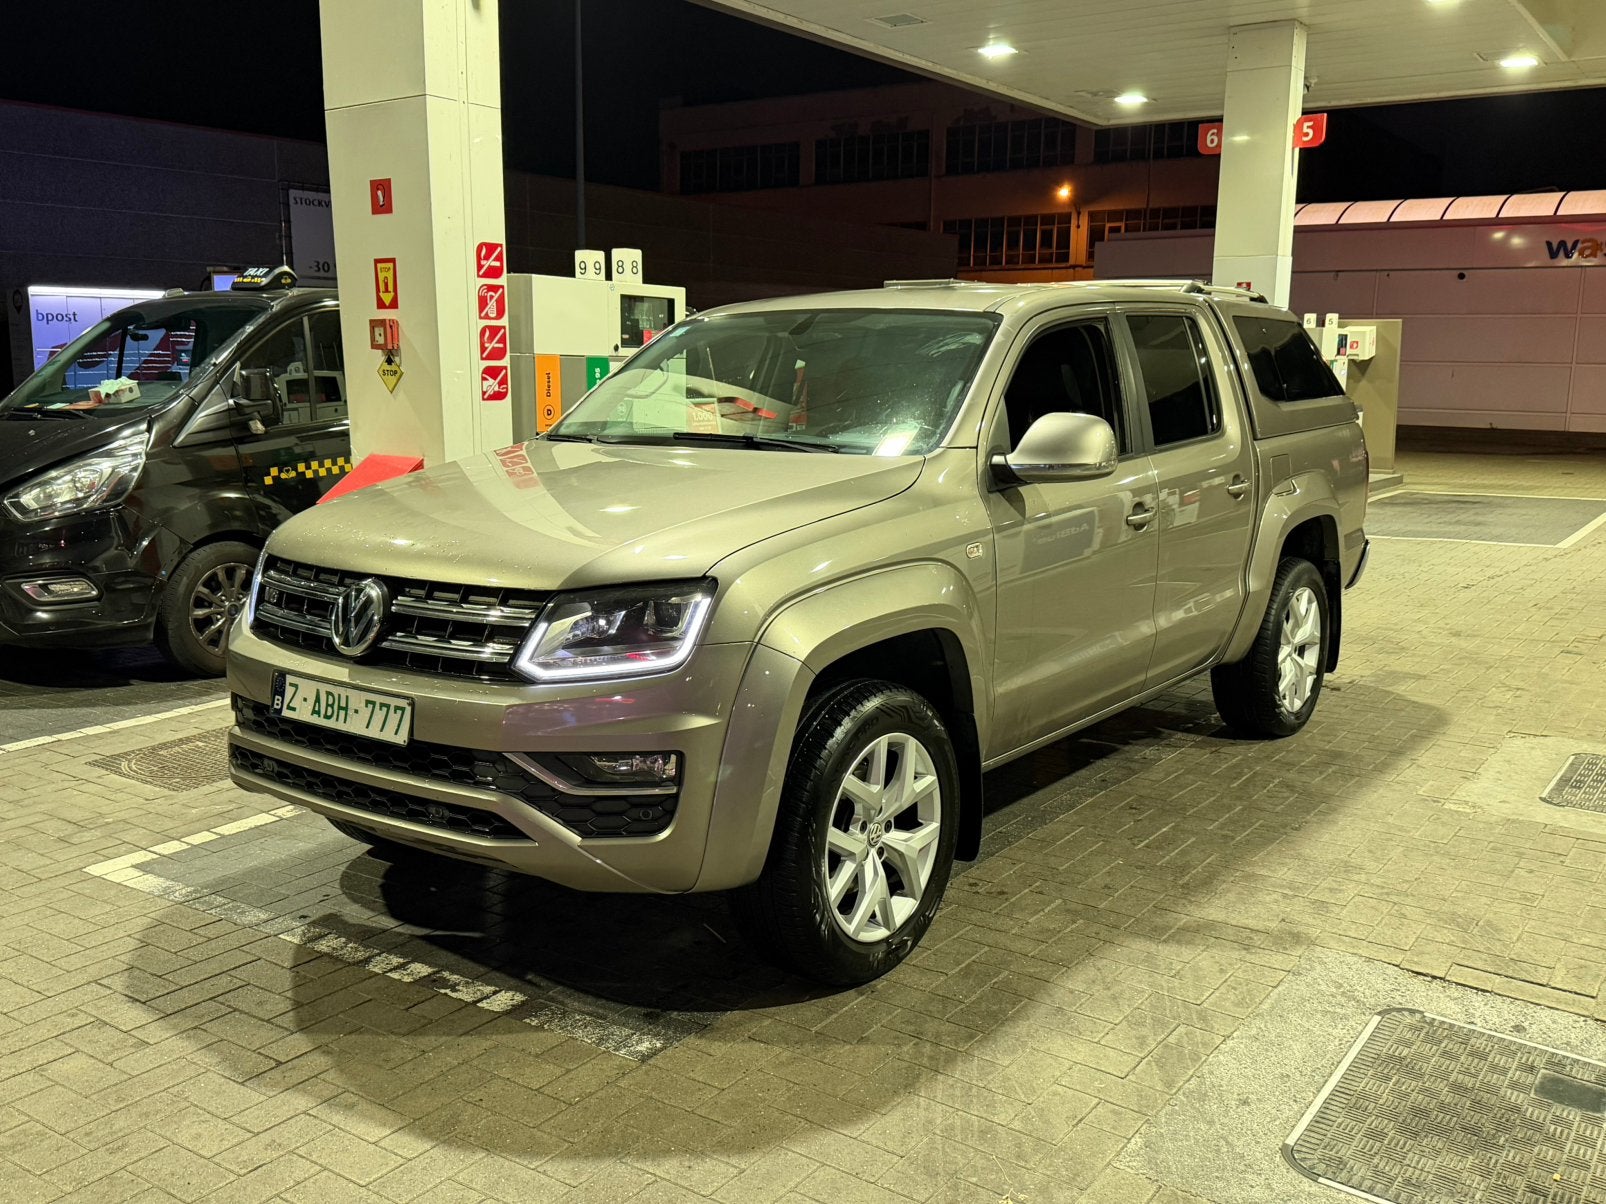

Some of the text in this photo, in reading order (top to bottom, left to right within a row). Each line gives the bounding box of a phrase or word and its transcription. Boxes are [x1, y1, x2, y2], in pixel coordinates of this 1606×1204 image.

[1206, 128, 1218, 148] 6
[1301, 121, 1314, 141] 5
[243, 267, 270, 276] TAXI
[379, 266, 391, 274] STOP
[578, 260, 602, 276] 9 9
[616, 259, 639, 275] 8 8
[36, 309, 78, 323] bpost
[382, 368, 398, 377] STOP
[546, 408, 553, 417] D
[273, 695, 282, 710] B
[286, 682, 407, 736] Z-ABH-777
